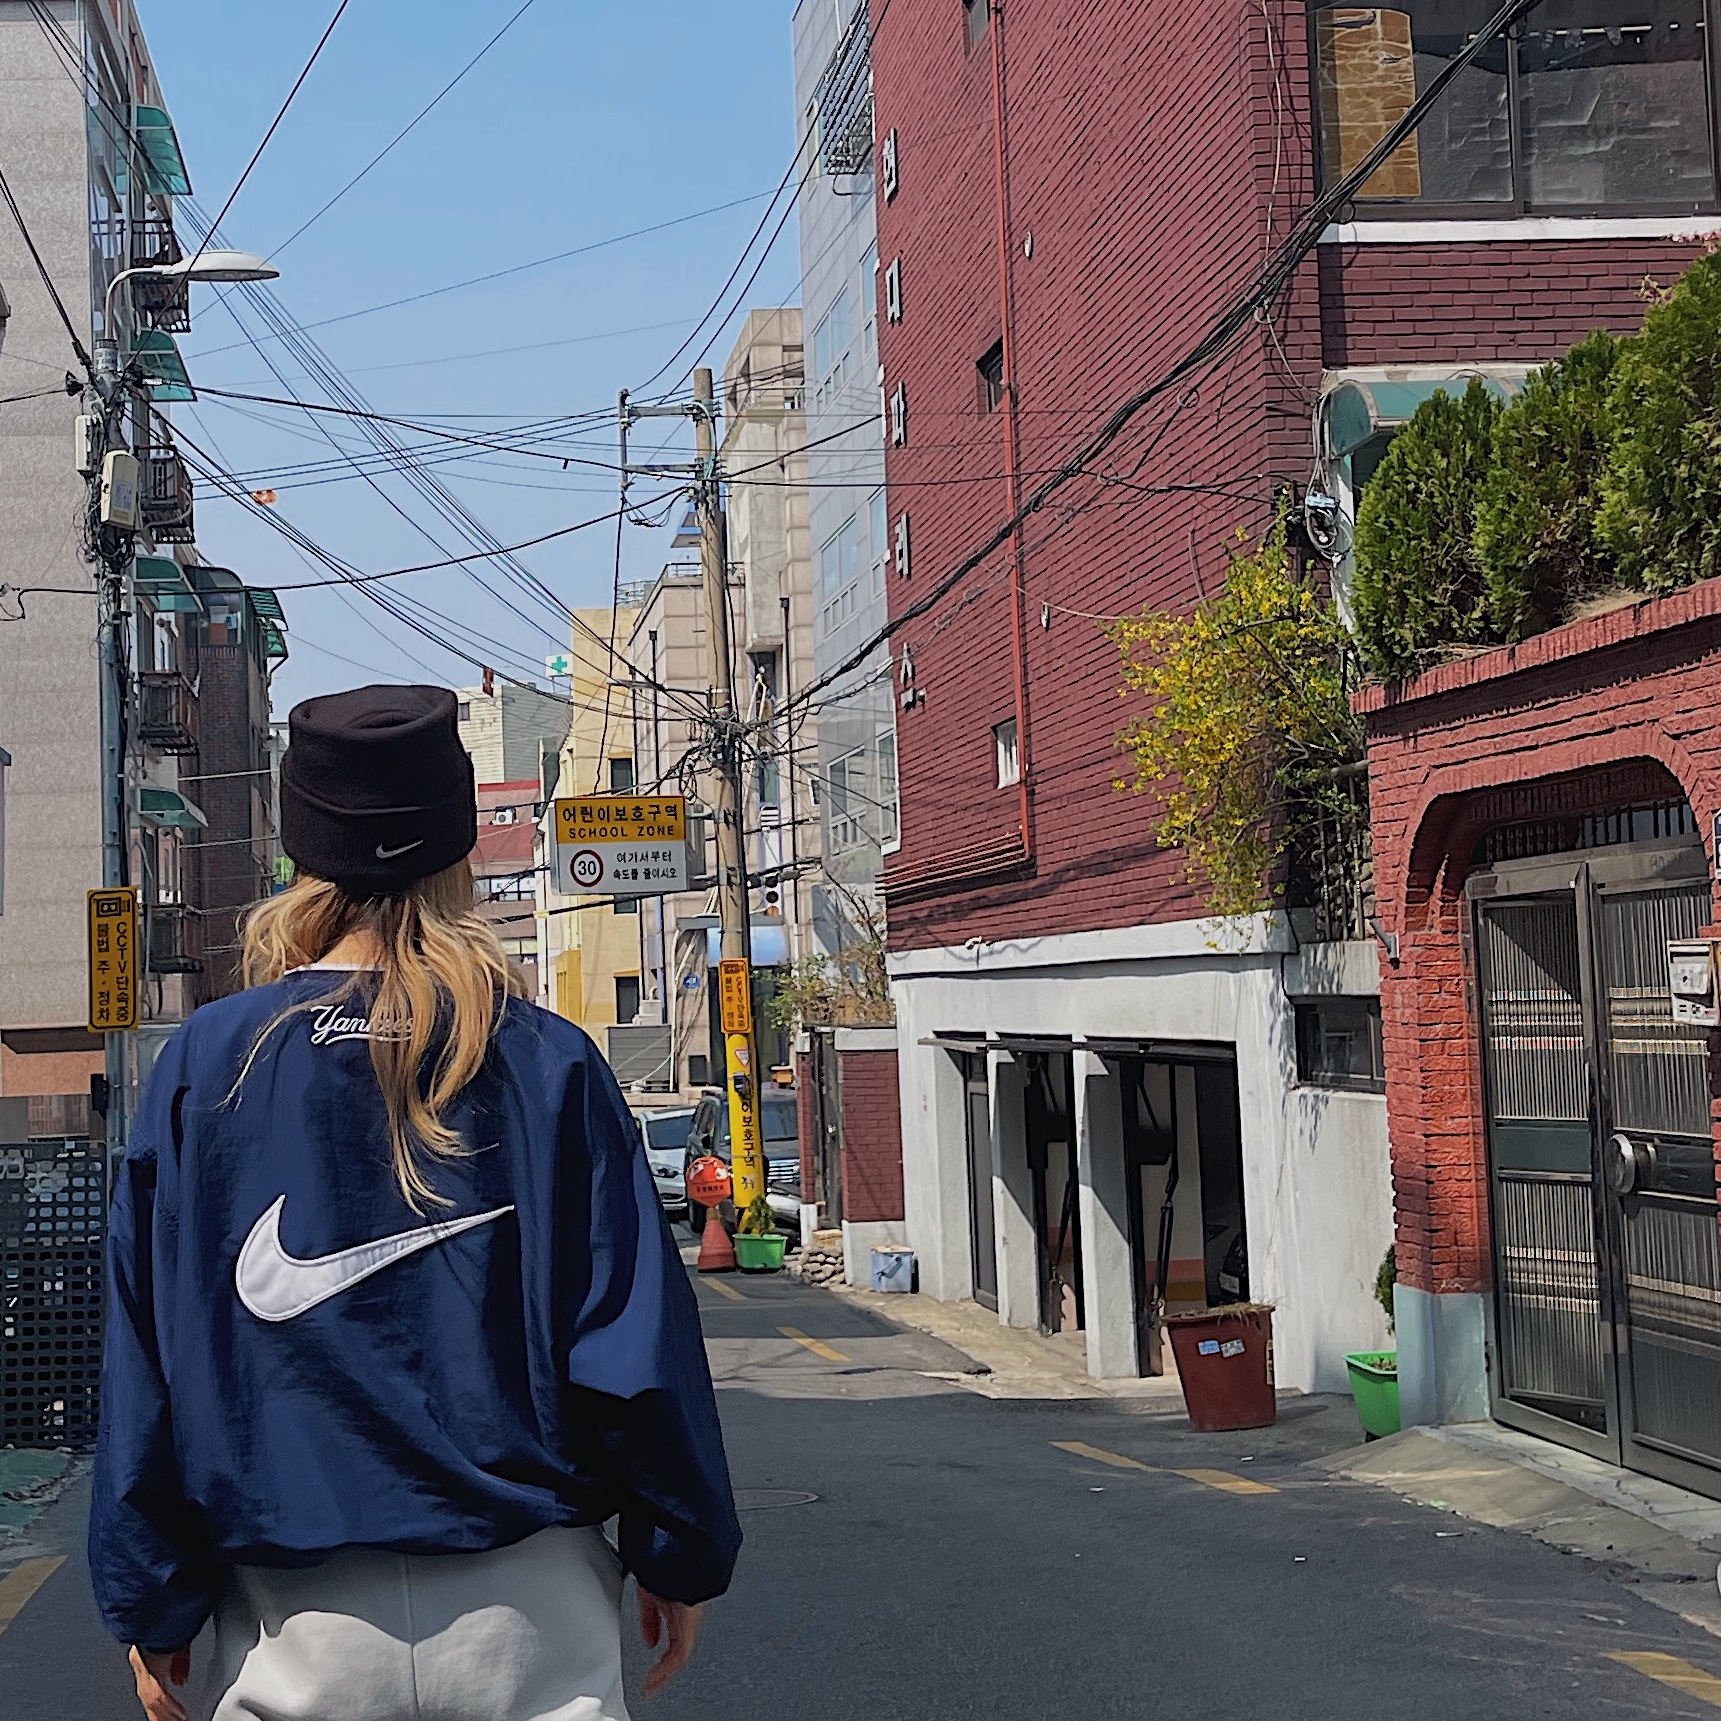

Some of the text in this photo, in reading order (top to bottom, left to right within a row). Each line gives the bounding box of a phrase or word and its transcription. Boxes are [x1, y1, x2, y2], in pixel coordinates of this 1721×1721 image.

[562, 804, 678, 824] 어린이보호구역
[568, 824, 675, 839] SCHOOL ZONE
[616, 849, 672, 863] 여기서부터
[577, 860, 597, 876] 30
